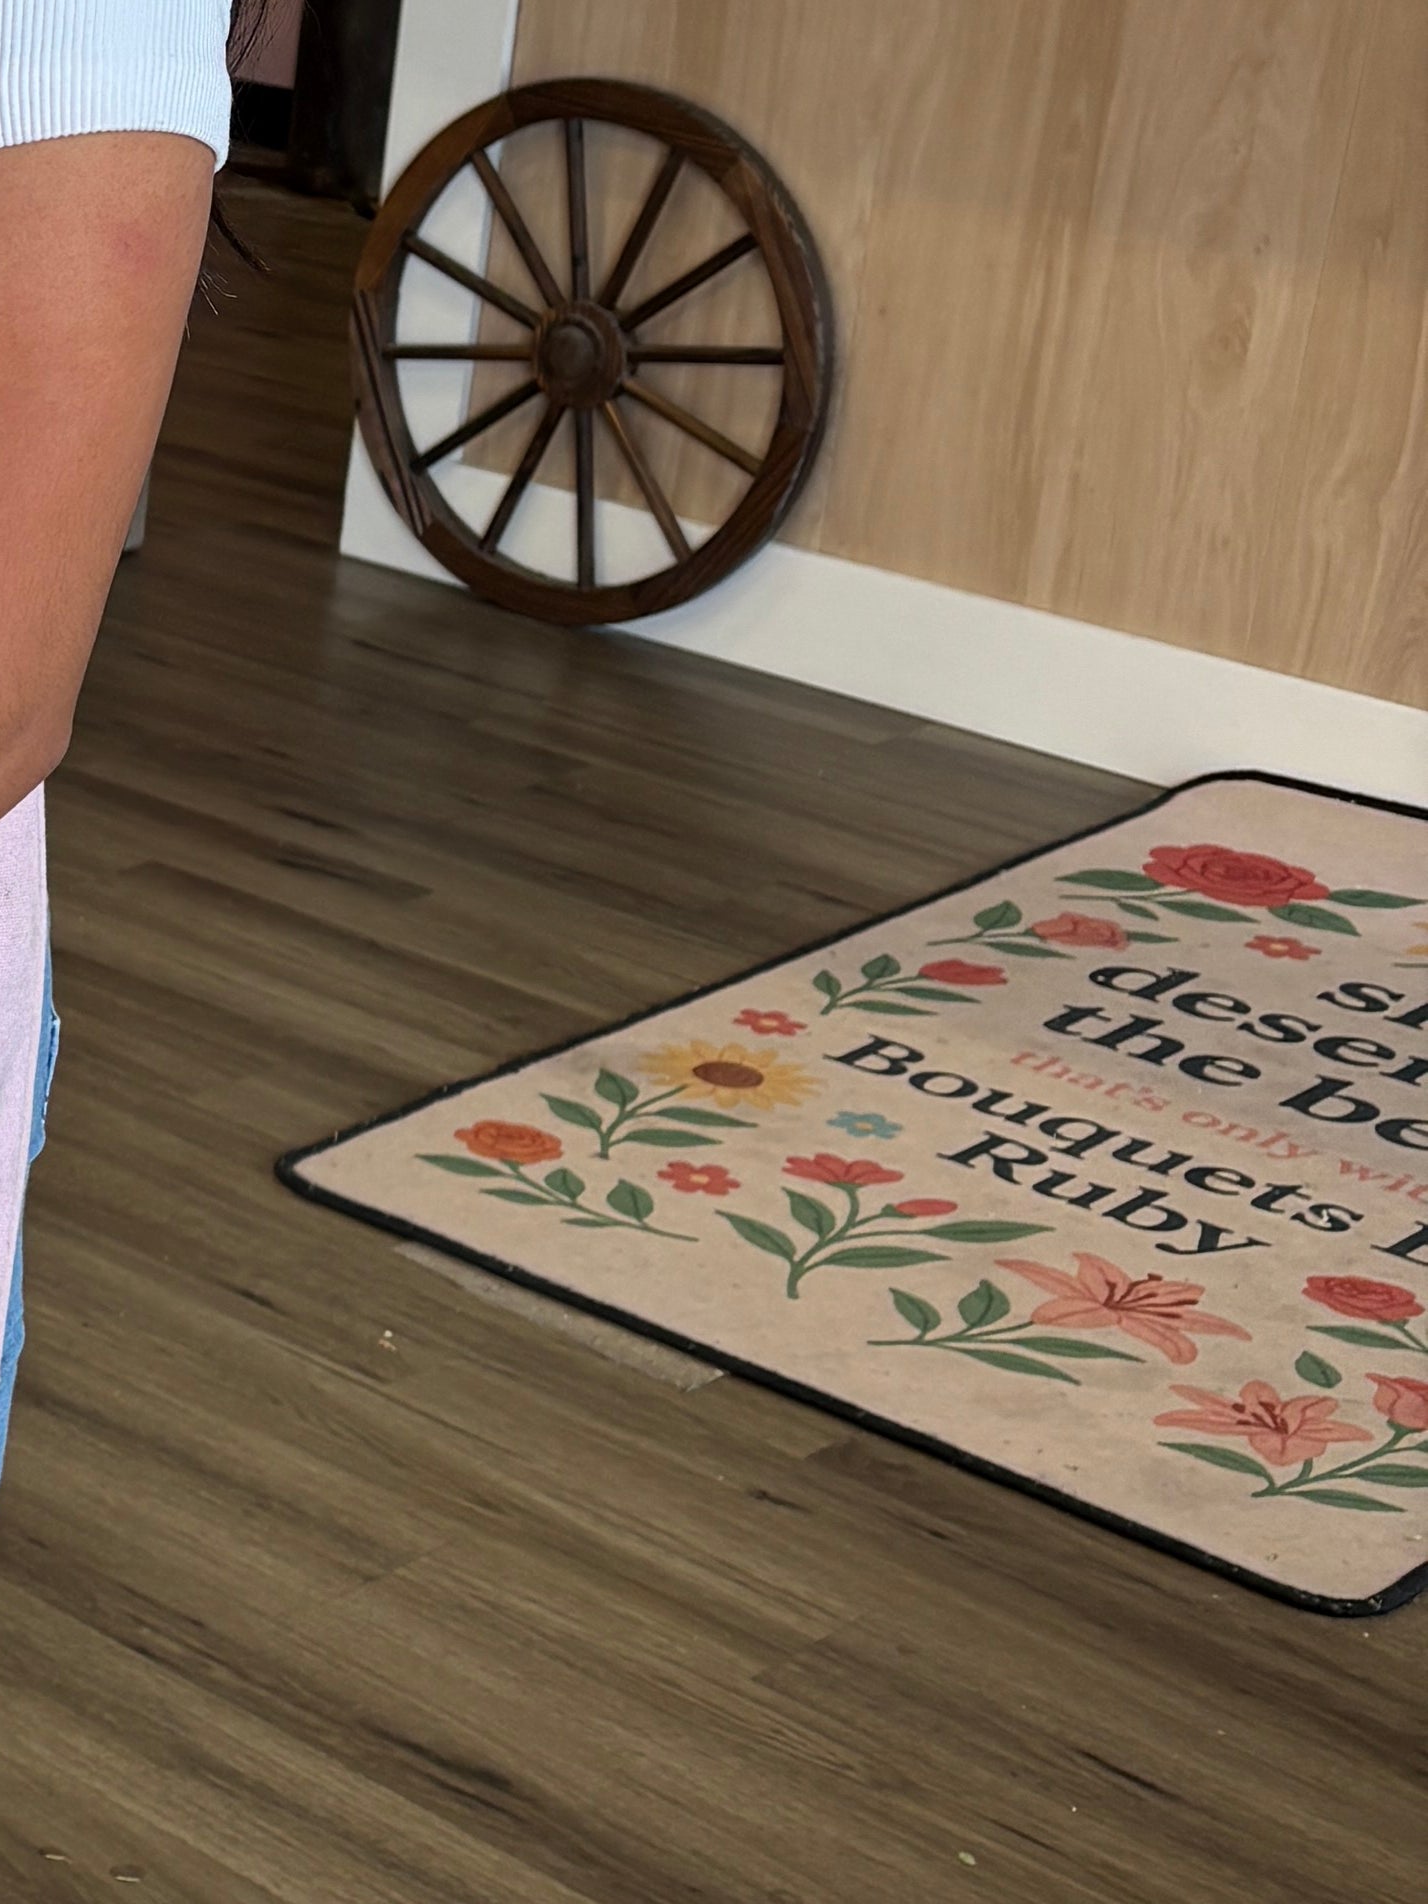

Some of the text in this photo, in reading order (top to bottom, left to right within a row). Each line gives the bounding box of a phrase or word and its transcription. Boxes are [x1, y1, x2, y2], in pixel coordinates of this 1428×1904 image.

[1010, 1048, 1172, 1113] that's
[1181, 1110, 1322, 1160] only
[1043, 1004, 1262, 1087] the
[823, 1033, 1364, 1234] Bouquets
[937, 1130, 1273, 1256] Ruby
